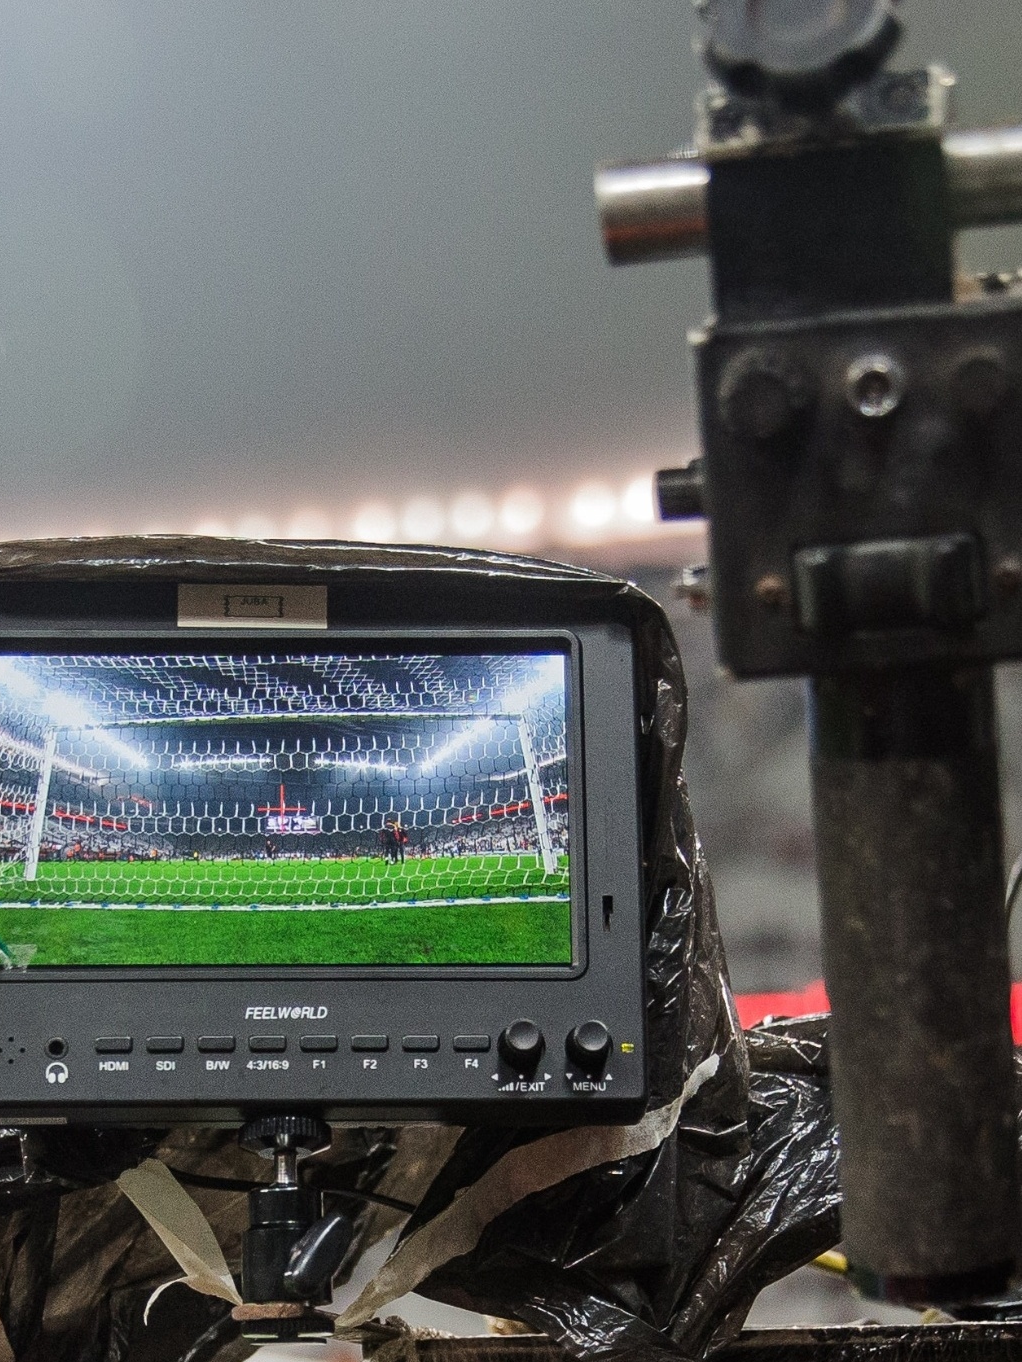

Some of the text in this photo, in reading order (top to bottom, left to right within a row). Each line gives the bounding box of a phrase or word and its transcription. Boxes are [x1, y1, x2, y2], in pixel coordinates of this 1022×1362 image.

[244, 1006, 328, 1020] FEELWORLD
[98, 1060, 130, 1071] HDMI
[155, 1060, 176, 1071] SDI
[205, 1060, 230, 1070] B/W
[246, 1060, 290, 1070] 4:3/16:9
[312, 1059, 326, 1069] F1
[363, 1059, 377, 1069] F2
[413, 1058, 428, 1069] F3
[464, 1058, 479, 1068] F4
[572, 1081, 607, 1092] MENU
